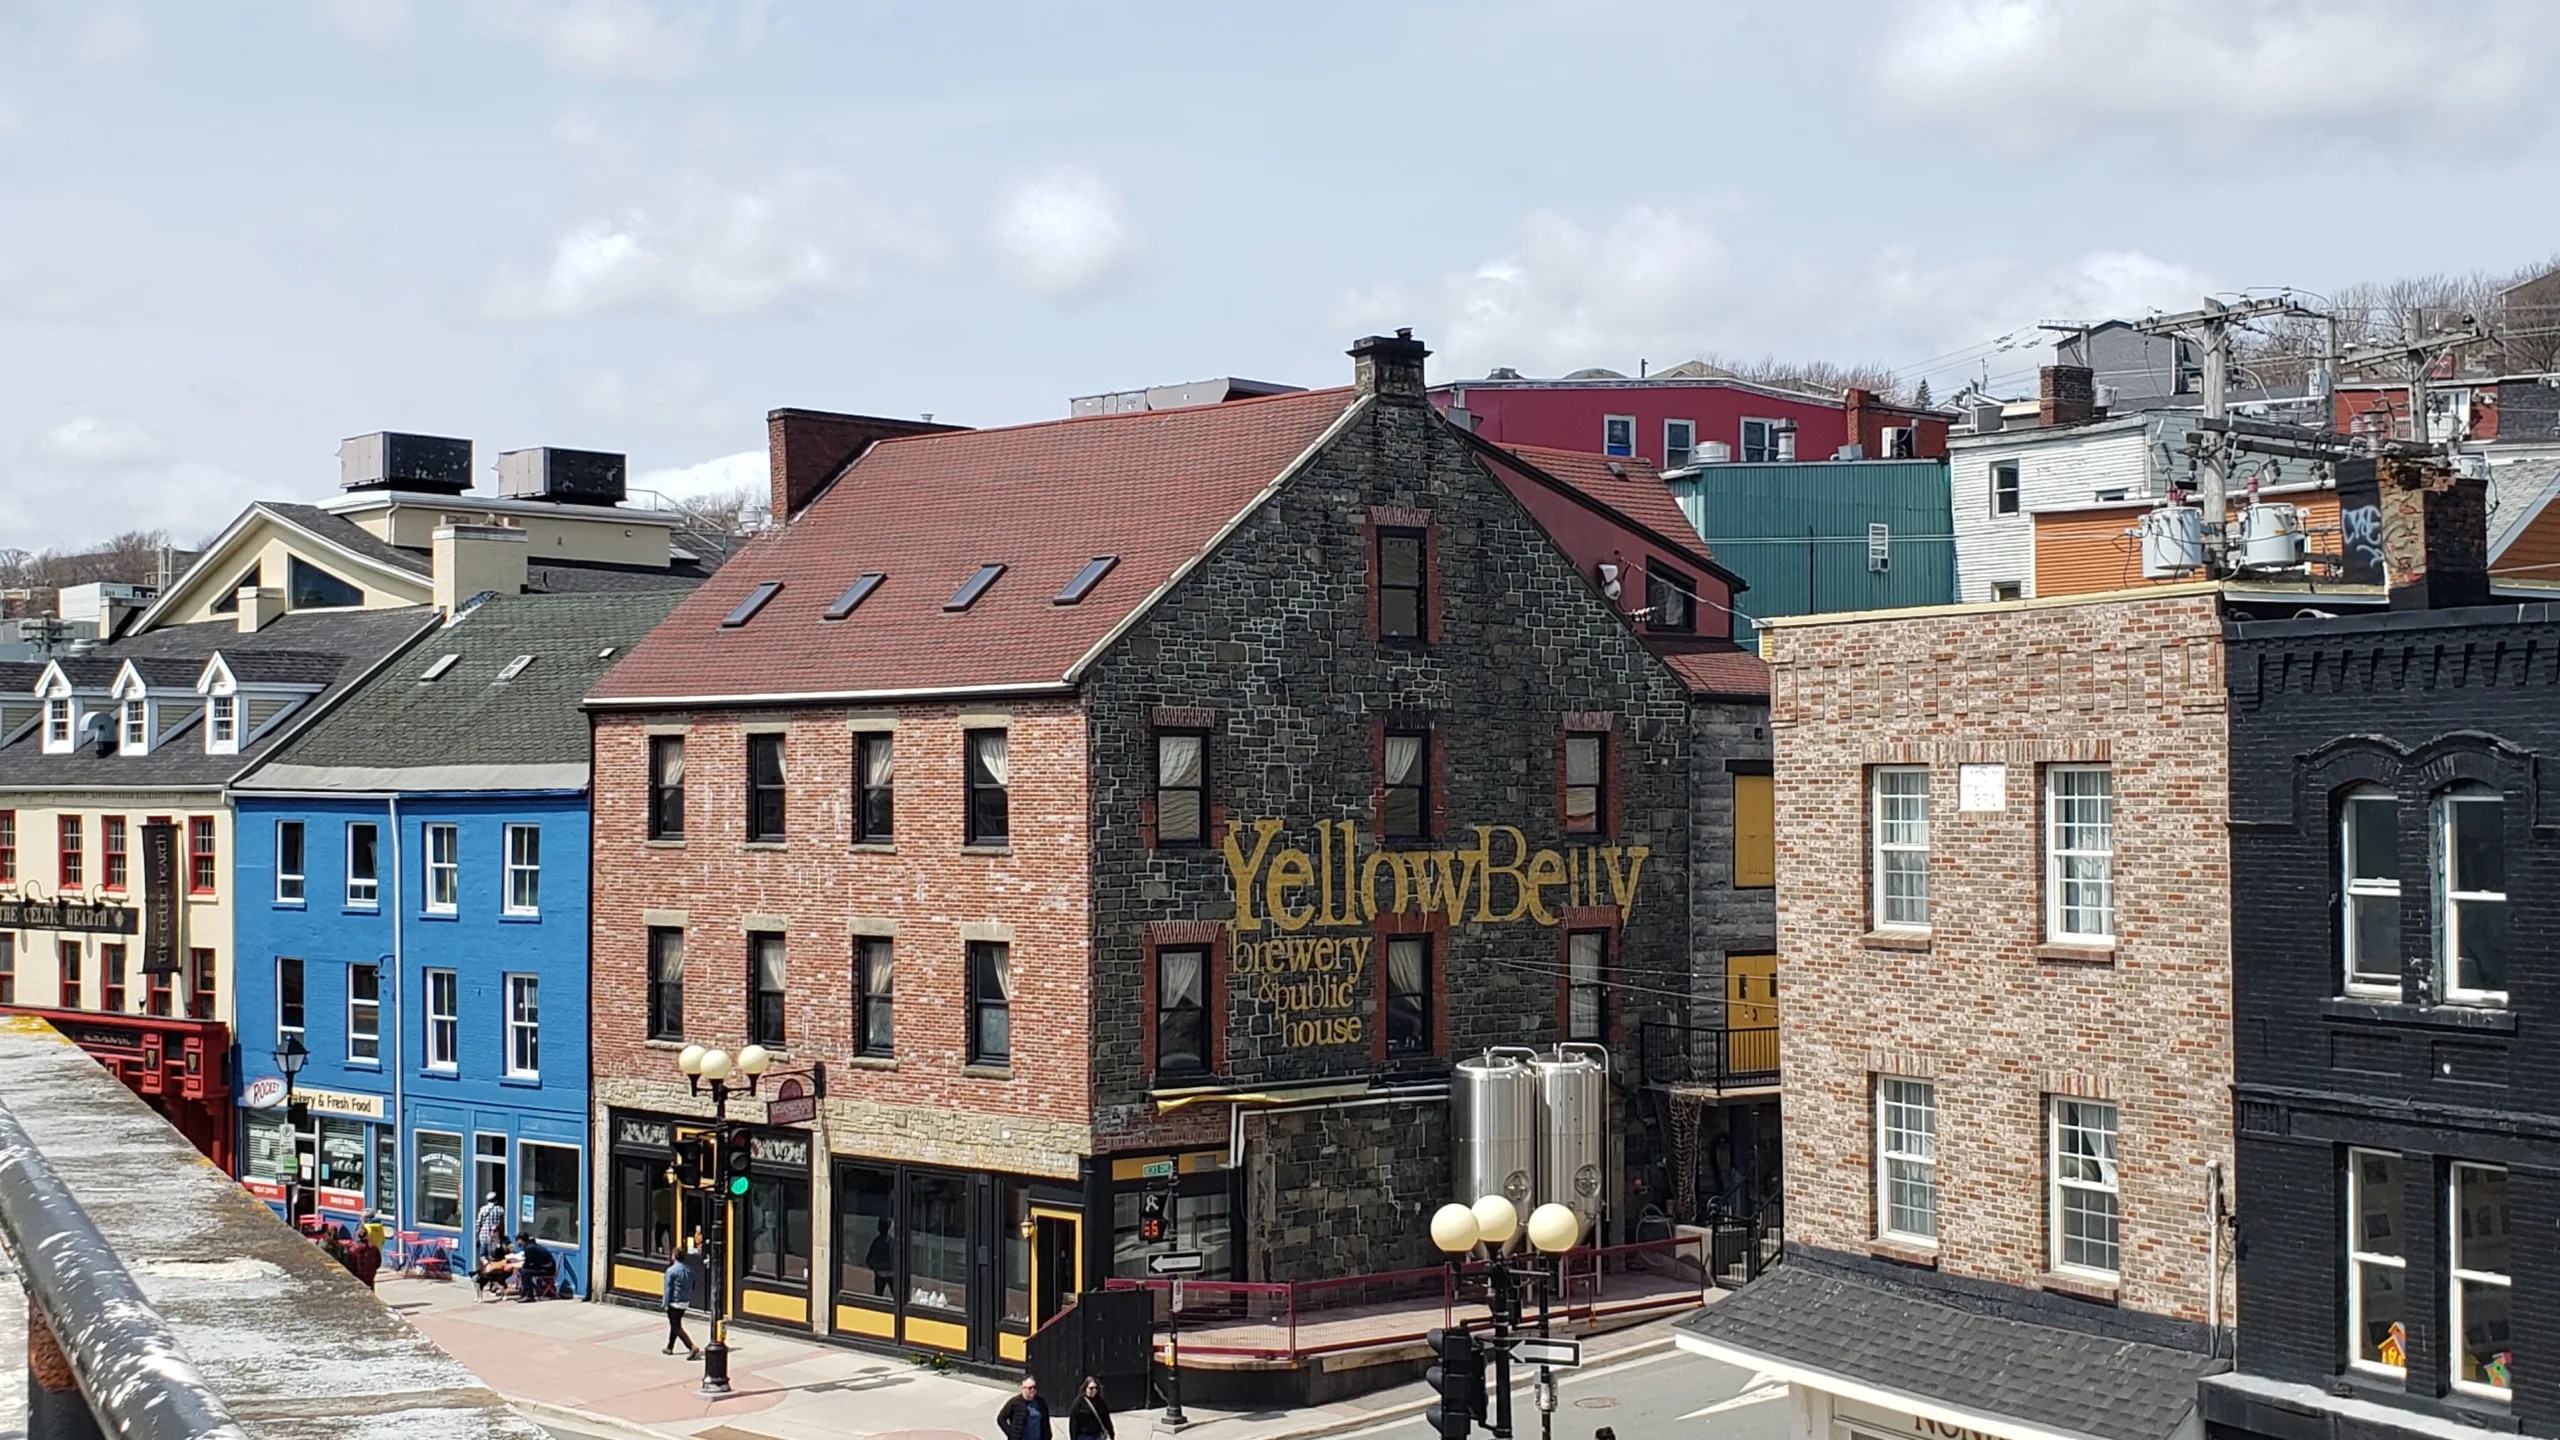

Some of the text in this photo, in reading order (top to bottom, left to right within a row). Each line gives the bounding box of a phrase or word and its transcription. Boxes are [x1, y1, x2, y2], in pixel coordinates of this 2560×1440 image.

[1224, 819, 1649, 937] YellowBelly
[23, 906, 60, 924] CELTIC
[66, 908, 108, 927] HEARTH
[1233, 929, 1373, 984] brewery
[1280, 1012, 1362, 1048] house
[253, 1082, 280, 1105] ROCKET
[318, 1094, 325, 1107] &
[327, 1093, 350, 1110] Fresh
[351, 1099, 372, 1113] Food
